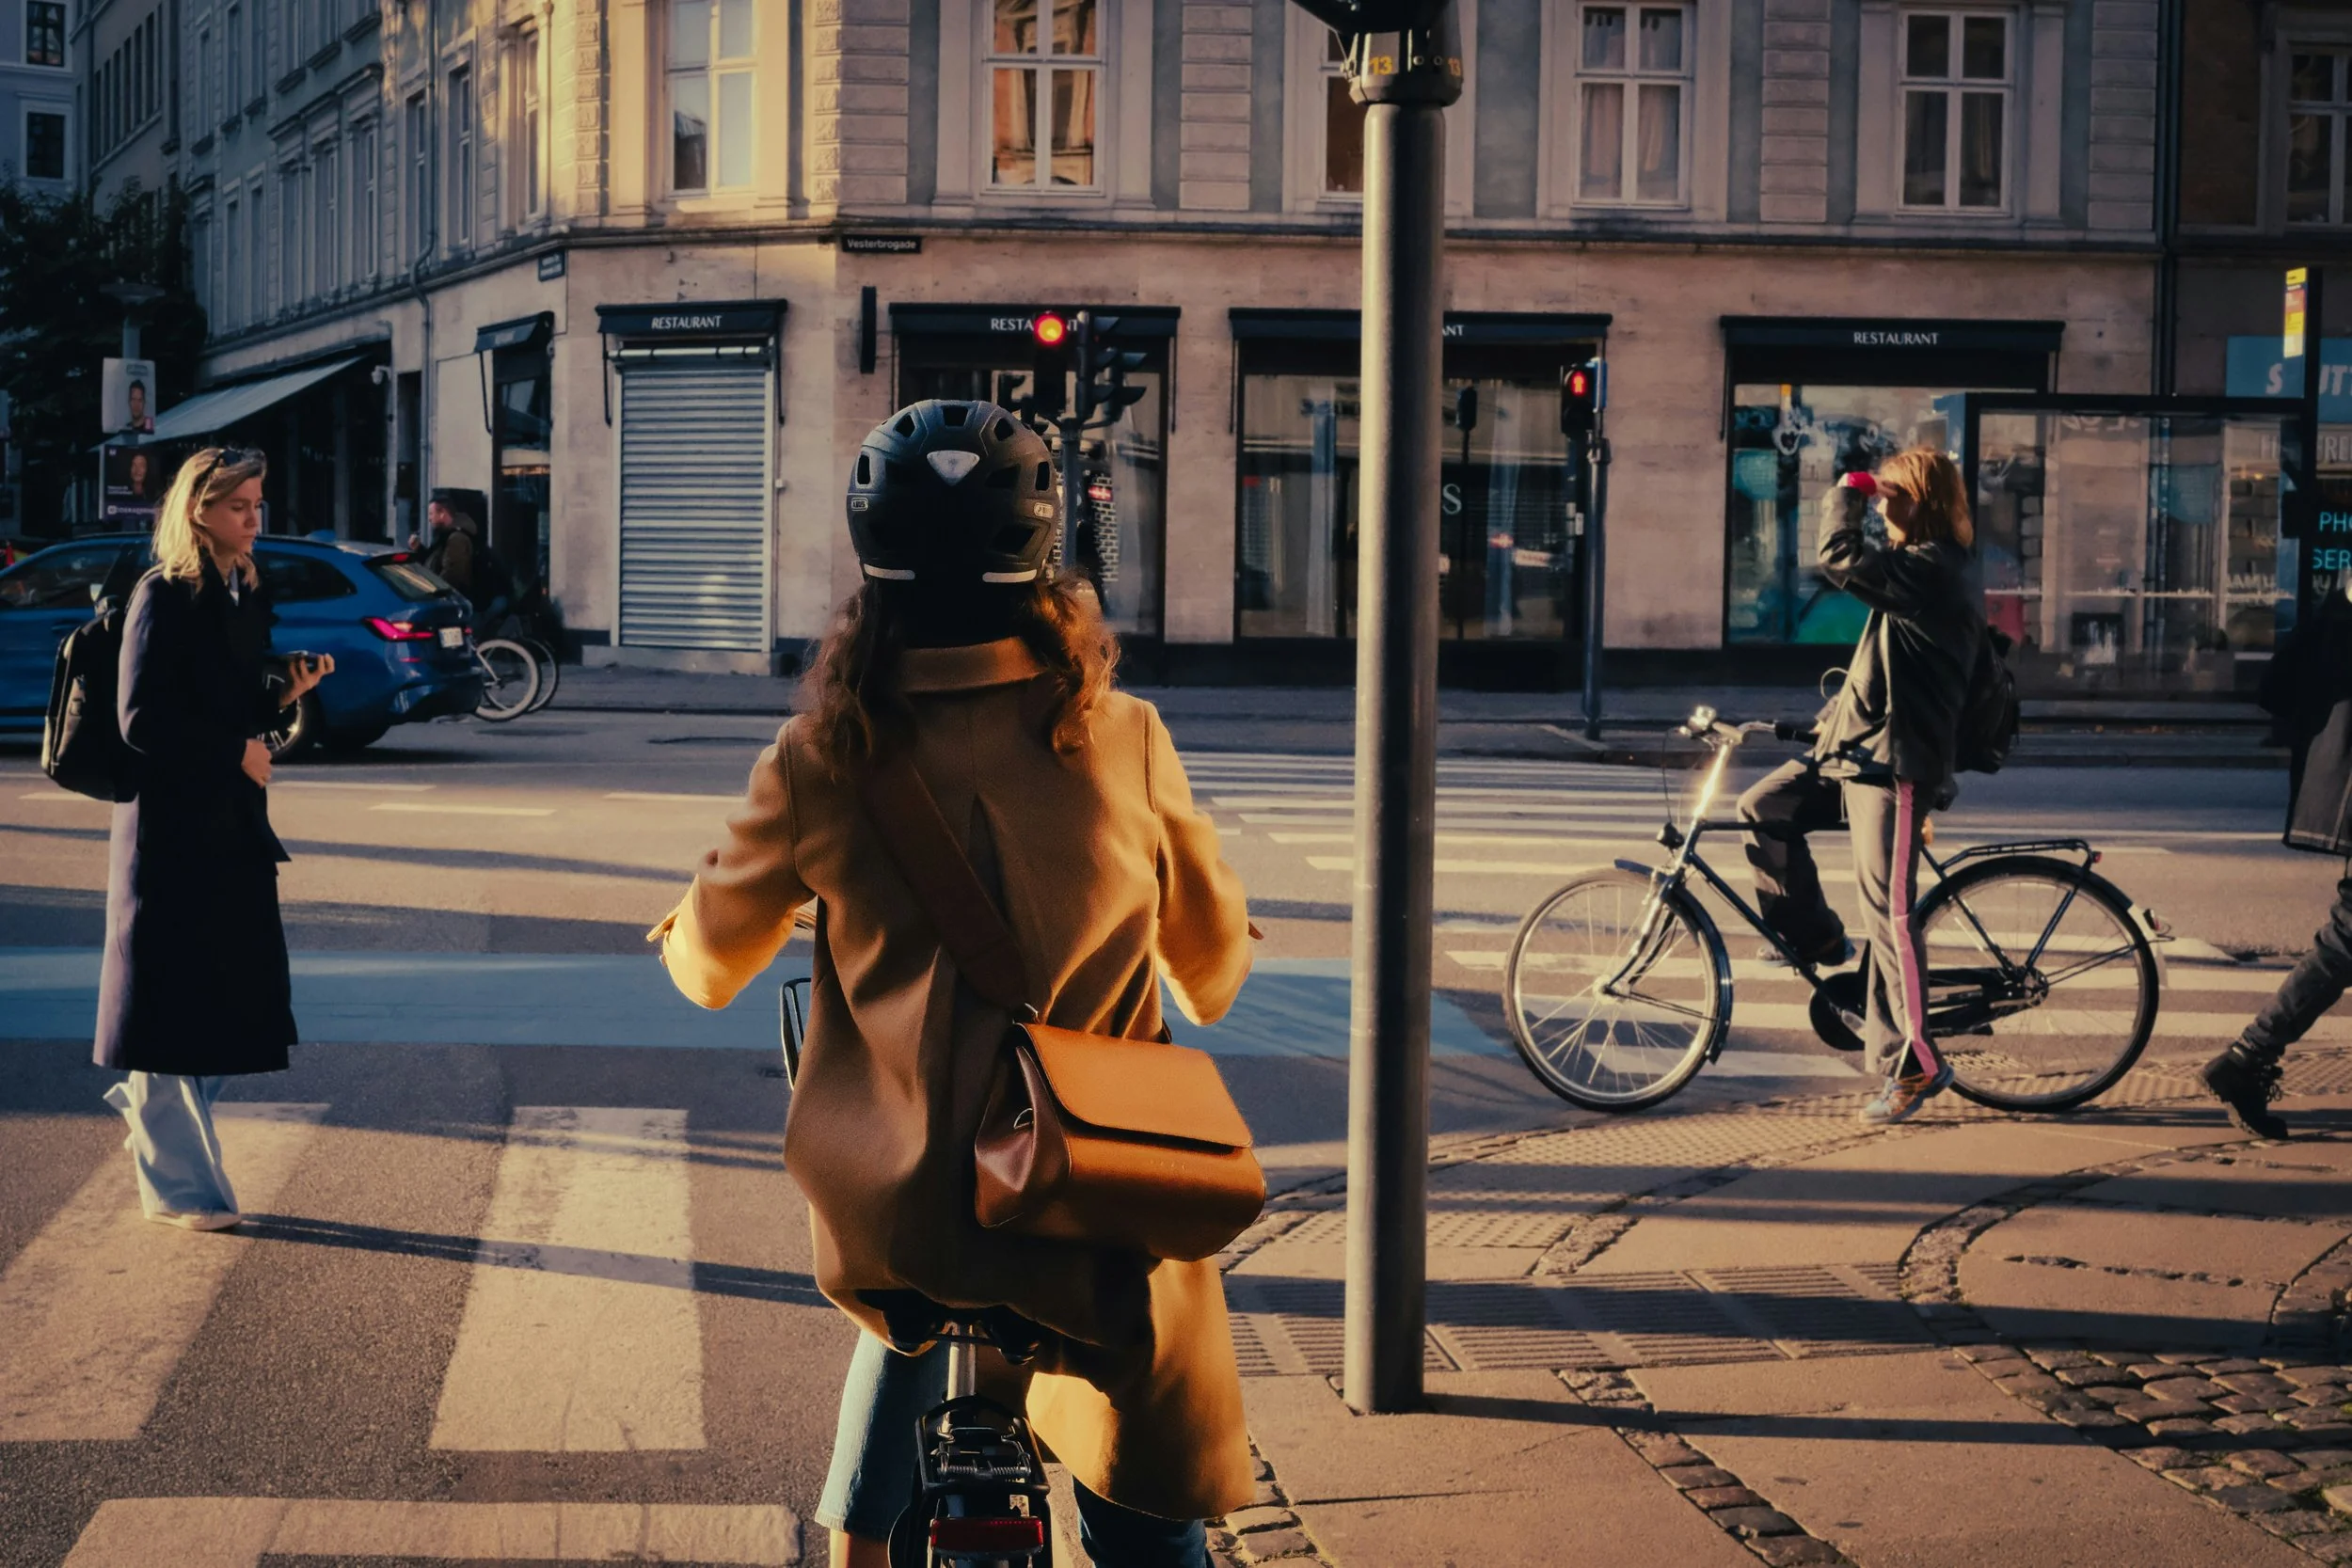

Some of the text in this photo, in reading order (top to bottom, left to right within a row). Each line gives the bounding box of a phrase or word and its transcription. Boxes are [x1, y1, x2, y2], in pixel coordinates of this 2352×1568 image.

[1369, 55, 1392, 75] 13
[1448, 57, 1461, 76] 13
[847, 238, 917, 251] Vesterbrogade
[651, 315, 723, 330] RESTAURANT
[1853, 332, 1940, 344] RESTAURANT
